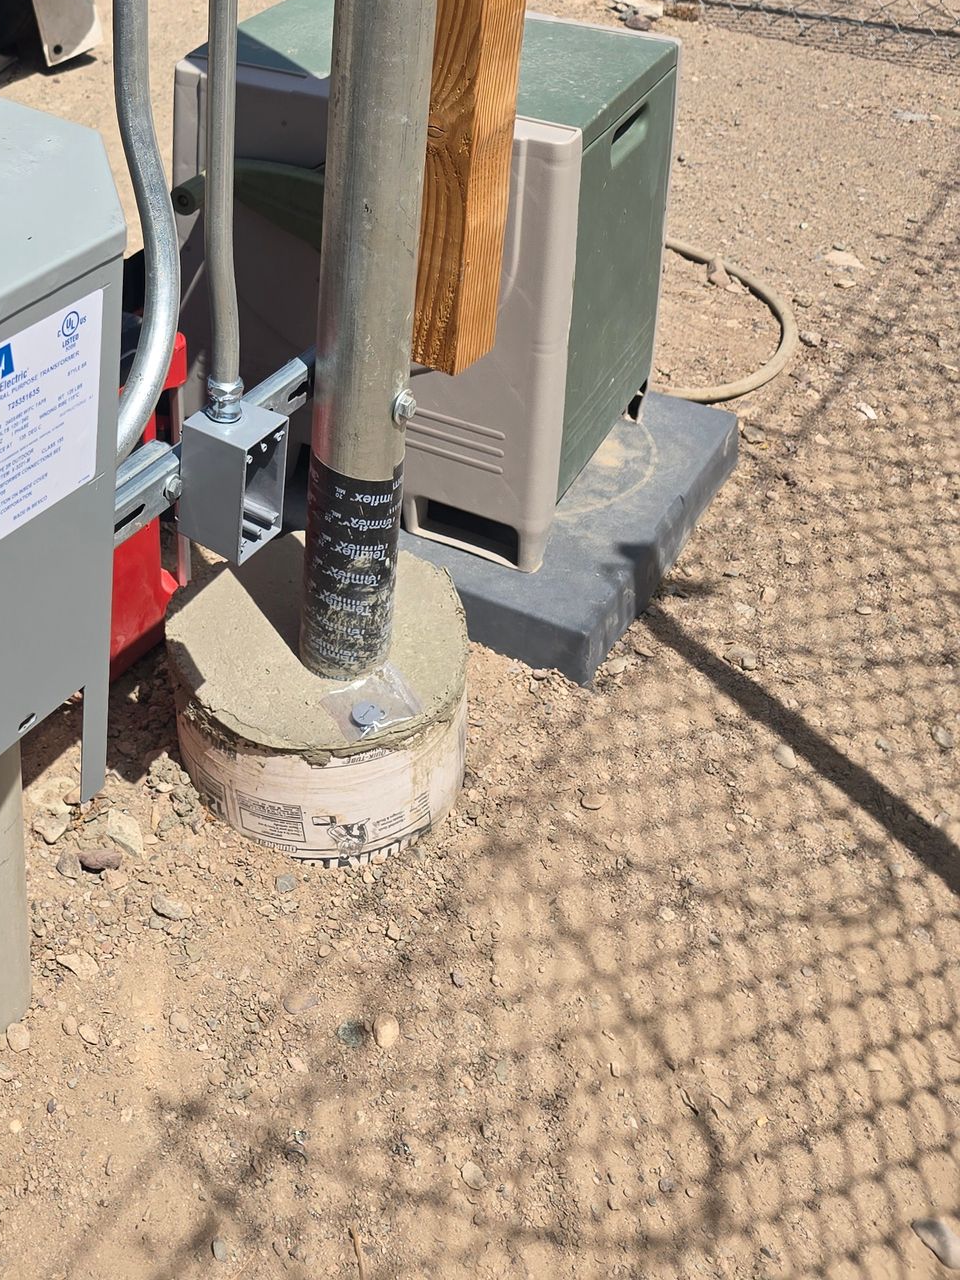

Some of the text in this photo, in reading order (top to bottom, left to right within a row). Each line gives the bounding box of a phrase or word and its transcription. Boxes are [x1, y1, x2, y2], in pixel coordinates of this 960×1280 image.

[62, 333, 80, 348] LISTED
[11, 374, 37, 393] PURPOSE
[40, 350, 79, 376] TRANSFORMER
[353, 492, 392, 506] mflex
